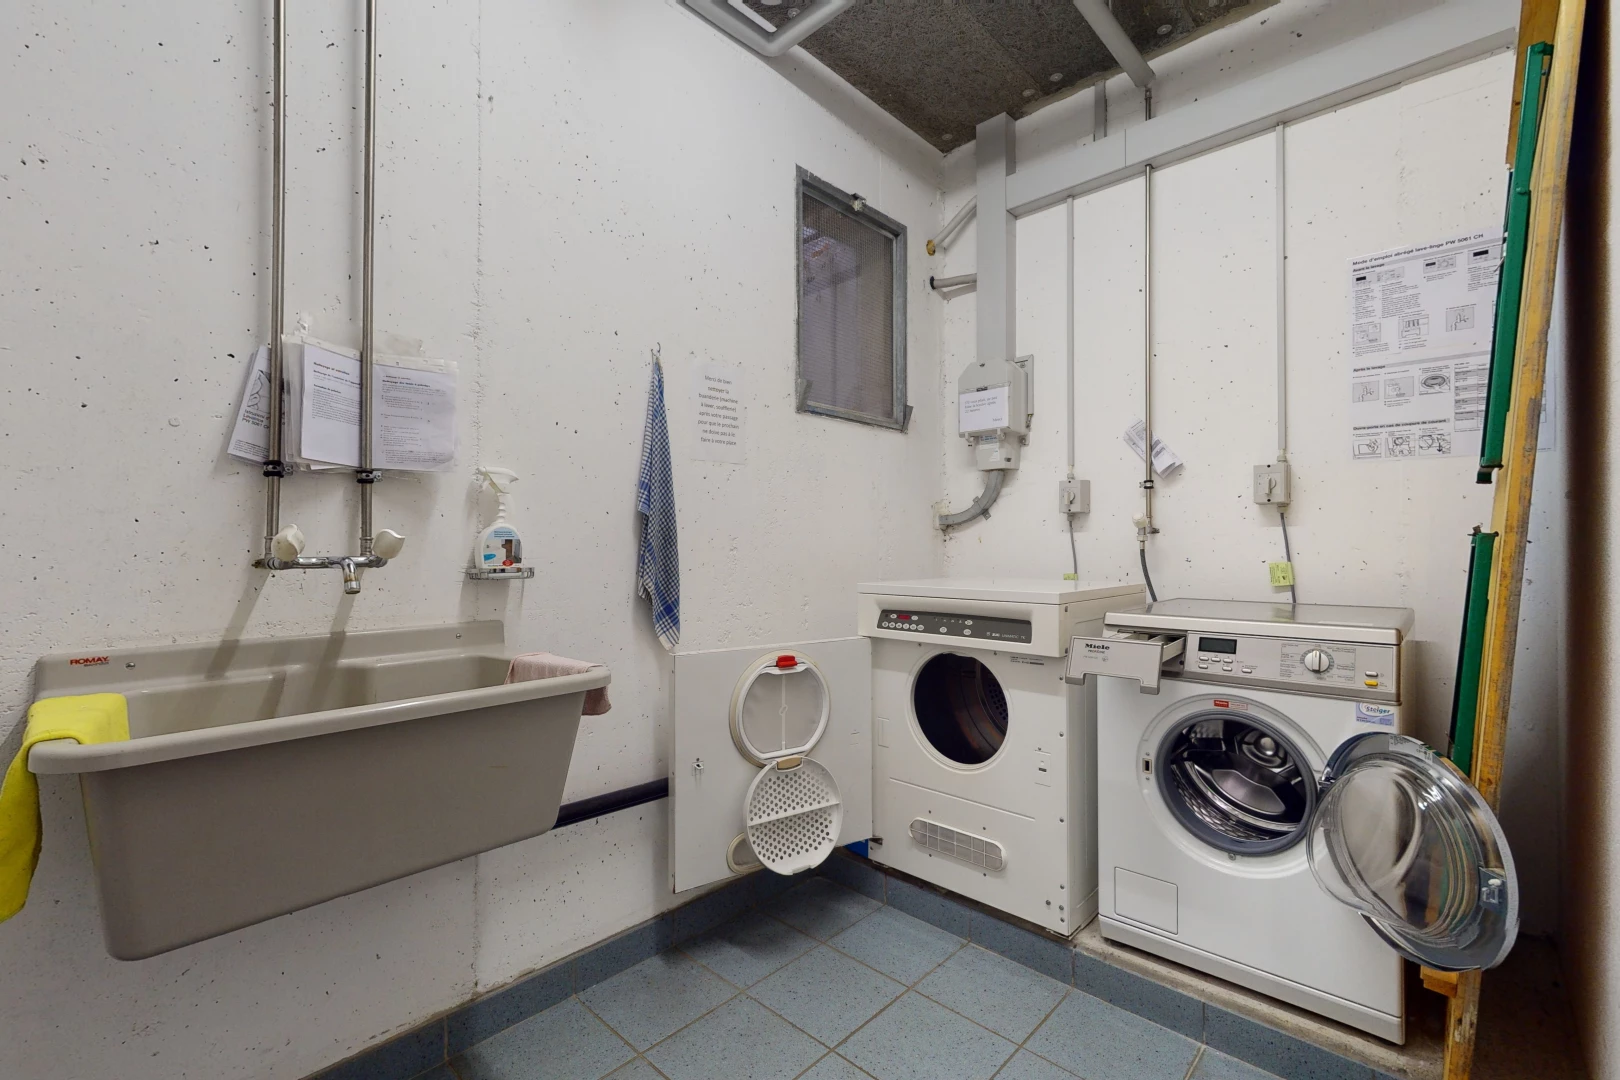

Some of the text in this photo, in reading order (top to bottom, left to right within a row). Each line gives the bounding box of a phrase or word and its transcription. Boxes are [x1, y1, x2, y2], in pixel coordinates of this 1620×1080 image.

[1369, 254, 1393, 262] d'emploi
[1394, 248, 1414, 256] abrégé
[1415, 243, 1444, 252] lave-linge
[70, 656, 109, 665] ROMAY
